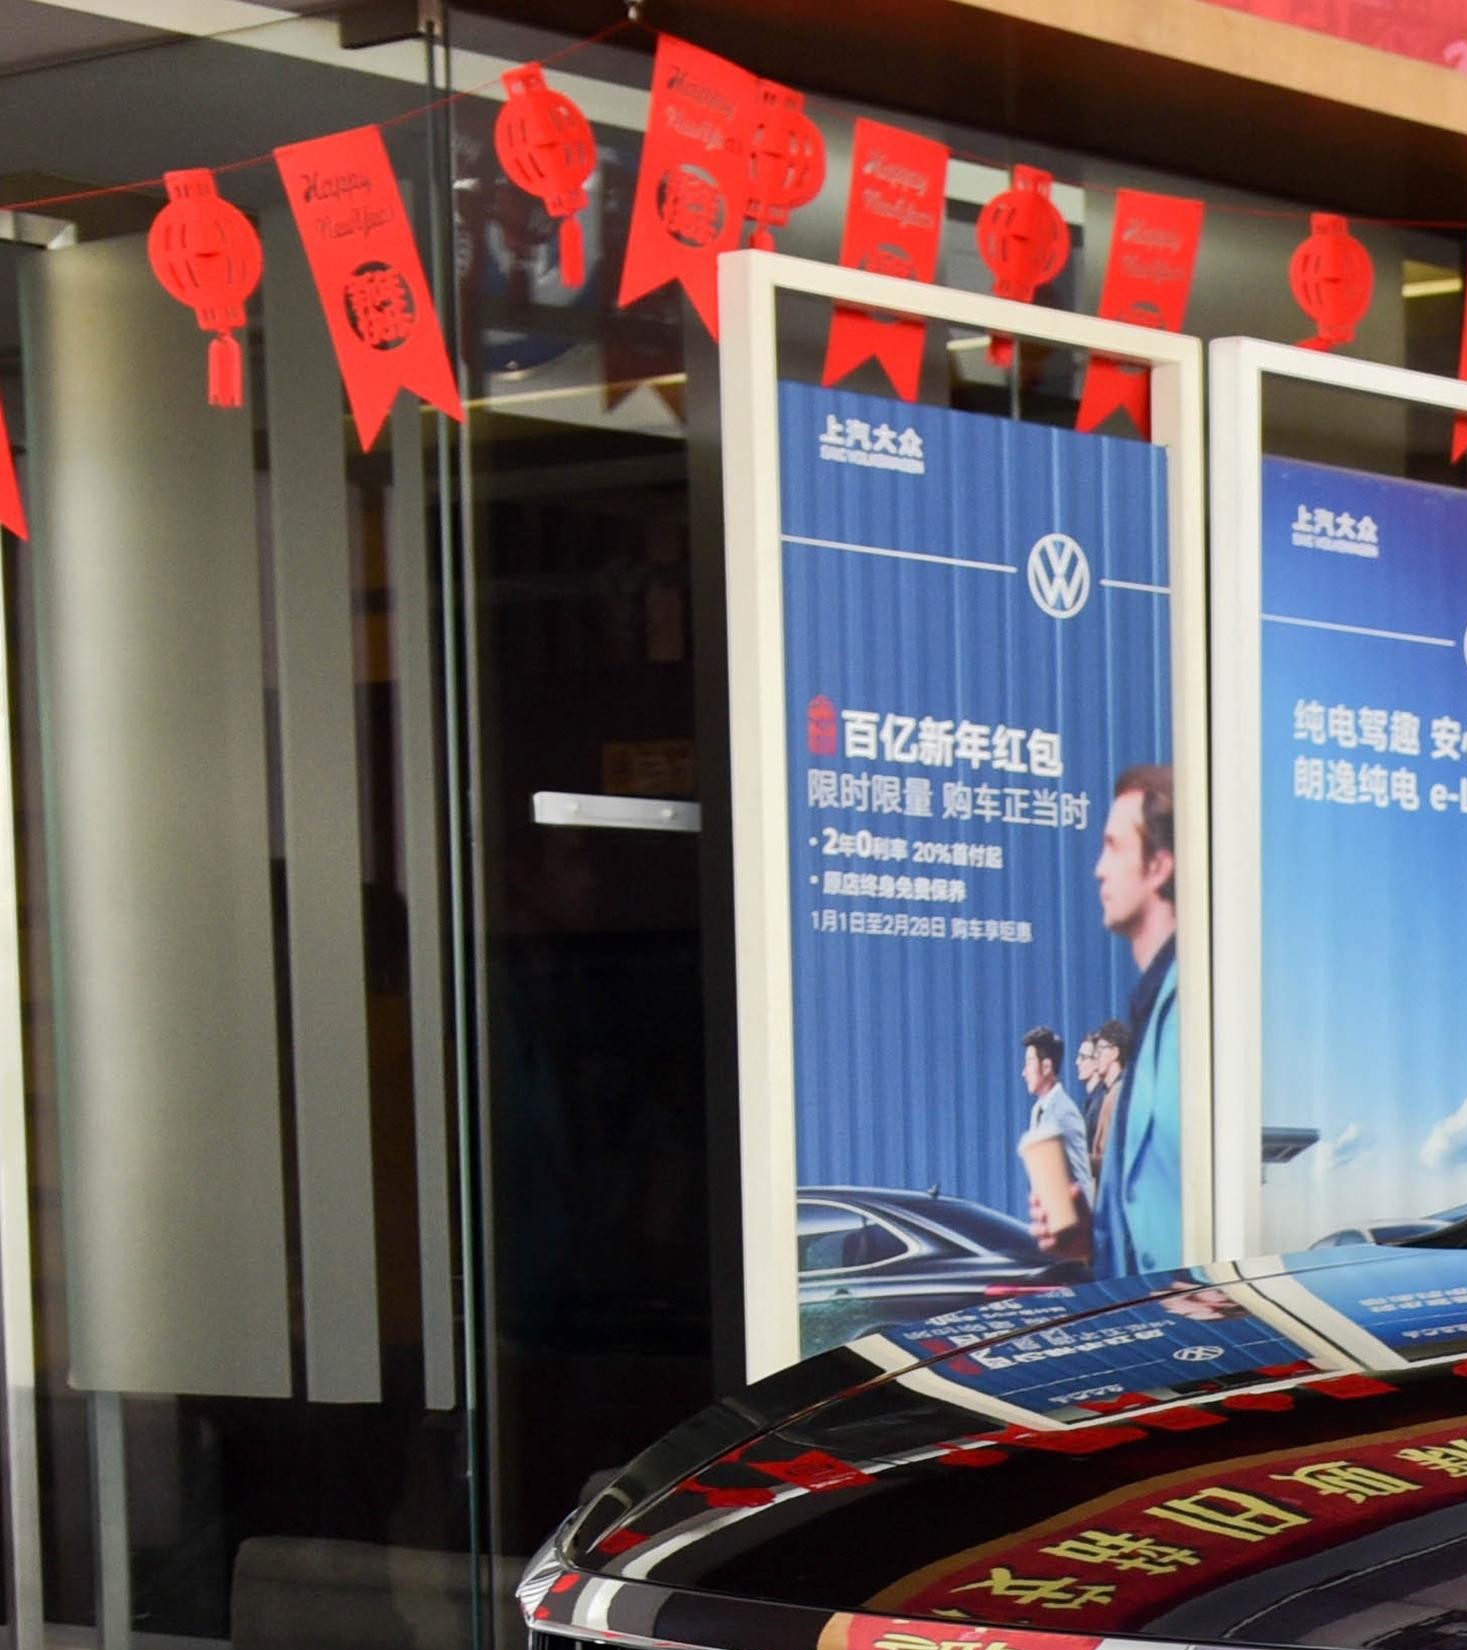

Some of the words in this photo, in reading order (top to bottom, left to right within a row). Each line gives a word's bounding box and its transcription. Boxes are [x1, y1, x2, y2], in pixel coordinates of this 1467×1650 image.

[301, 172, 372, 203] Happy
[819, 413, 924, 459] 上汽大众
[1291, 504, 1379, 545] 上汽大众
[841, 708, 1064, 778] 百亿新年红包
[1292, 698, 1421, 755] 纯电驾趣
[807, 768, 934, 818] 限时限量
[942, 781, 1091, 831] 购车正当时
[1292, 754, 1420, 812] 朗逸纯电
[811, 909, 947, 938] 1月1日至2月28日
